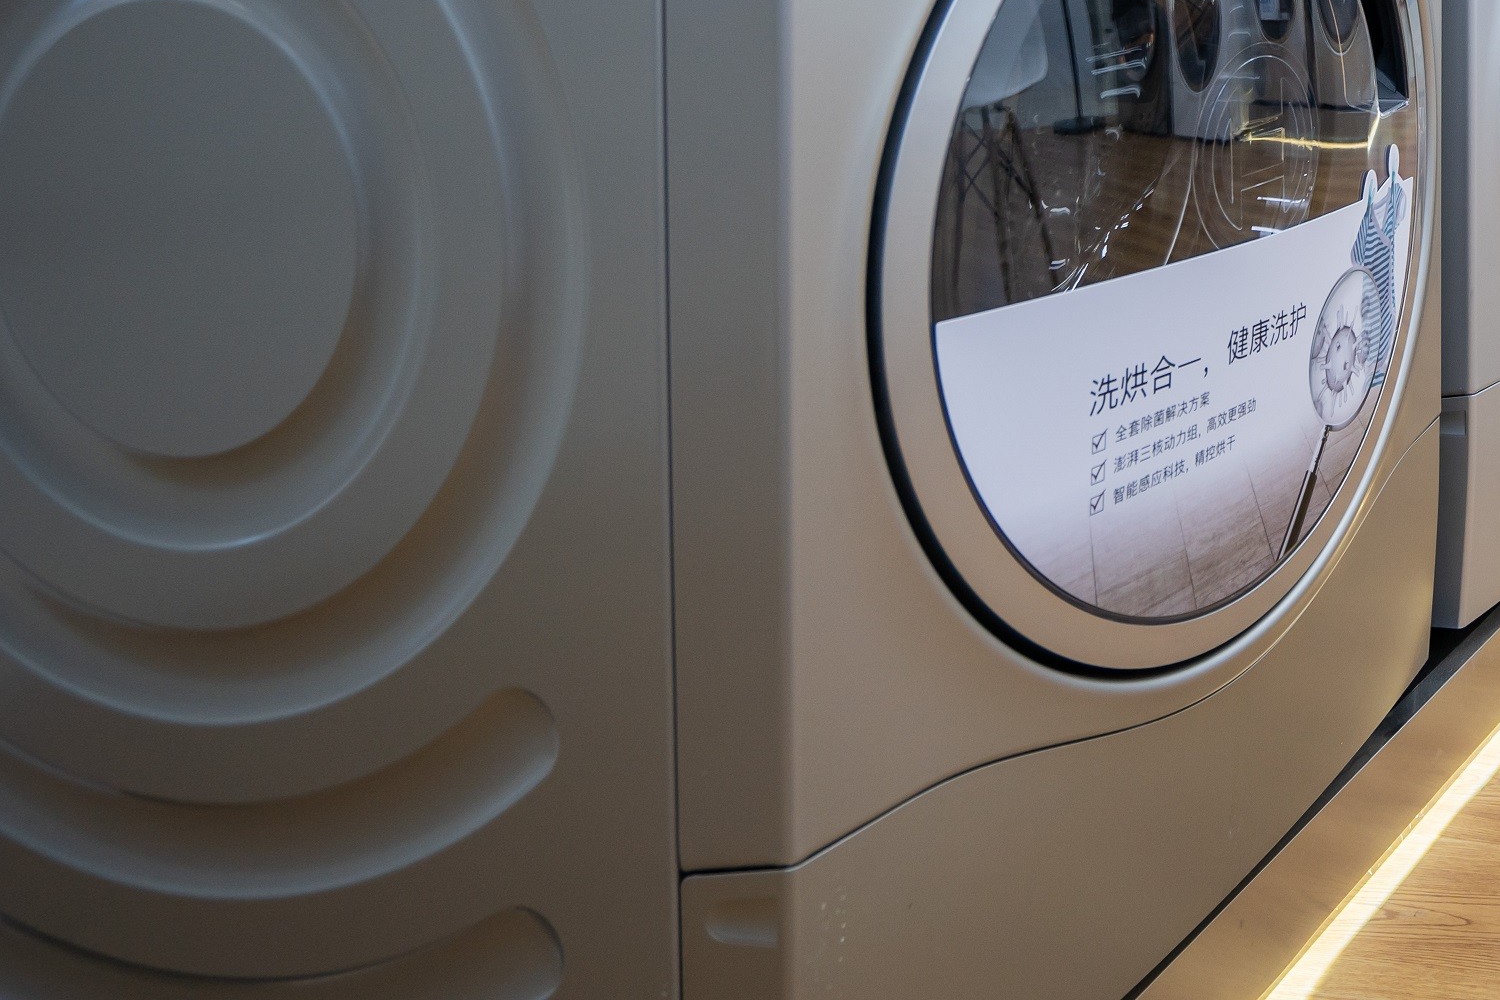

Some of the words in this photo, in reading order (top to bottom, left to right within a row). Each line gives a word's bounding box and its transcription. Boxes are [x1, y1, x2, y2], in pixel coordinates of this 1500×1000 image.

[1089, 301, 1307, 417] 洗烘合一，健康洗护
[1114, 390, 1211, 443] 全套除菌解决方案
